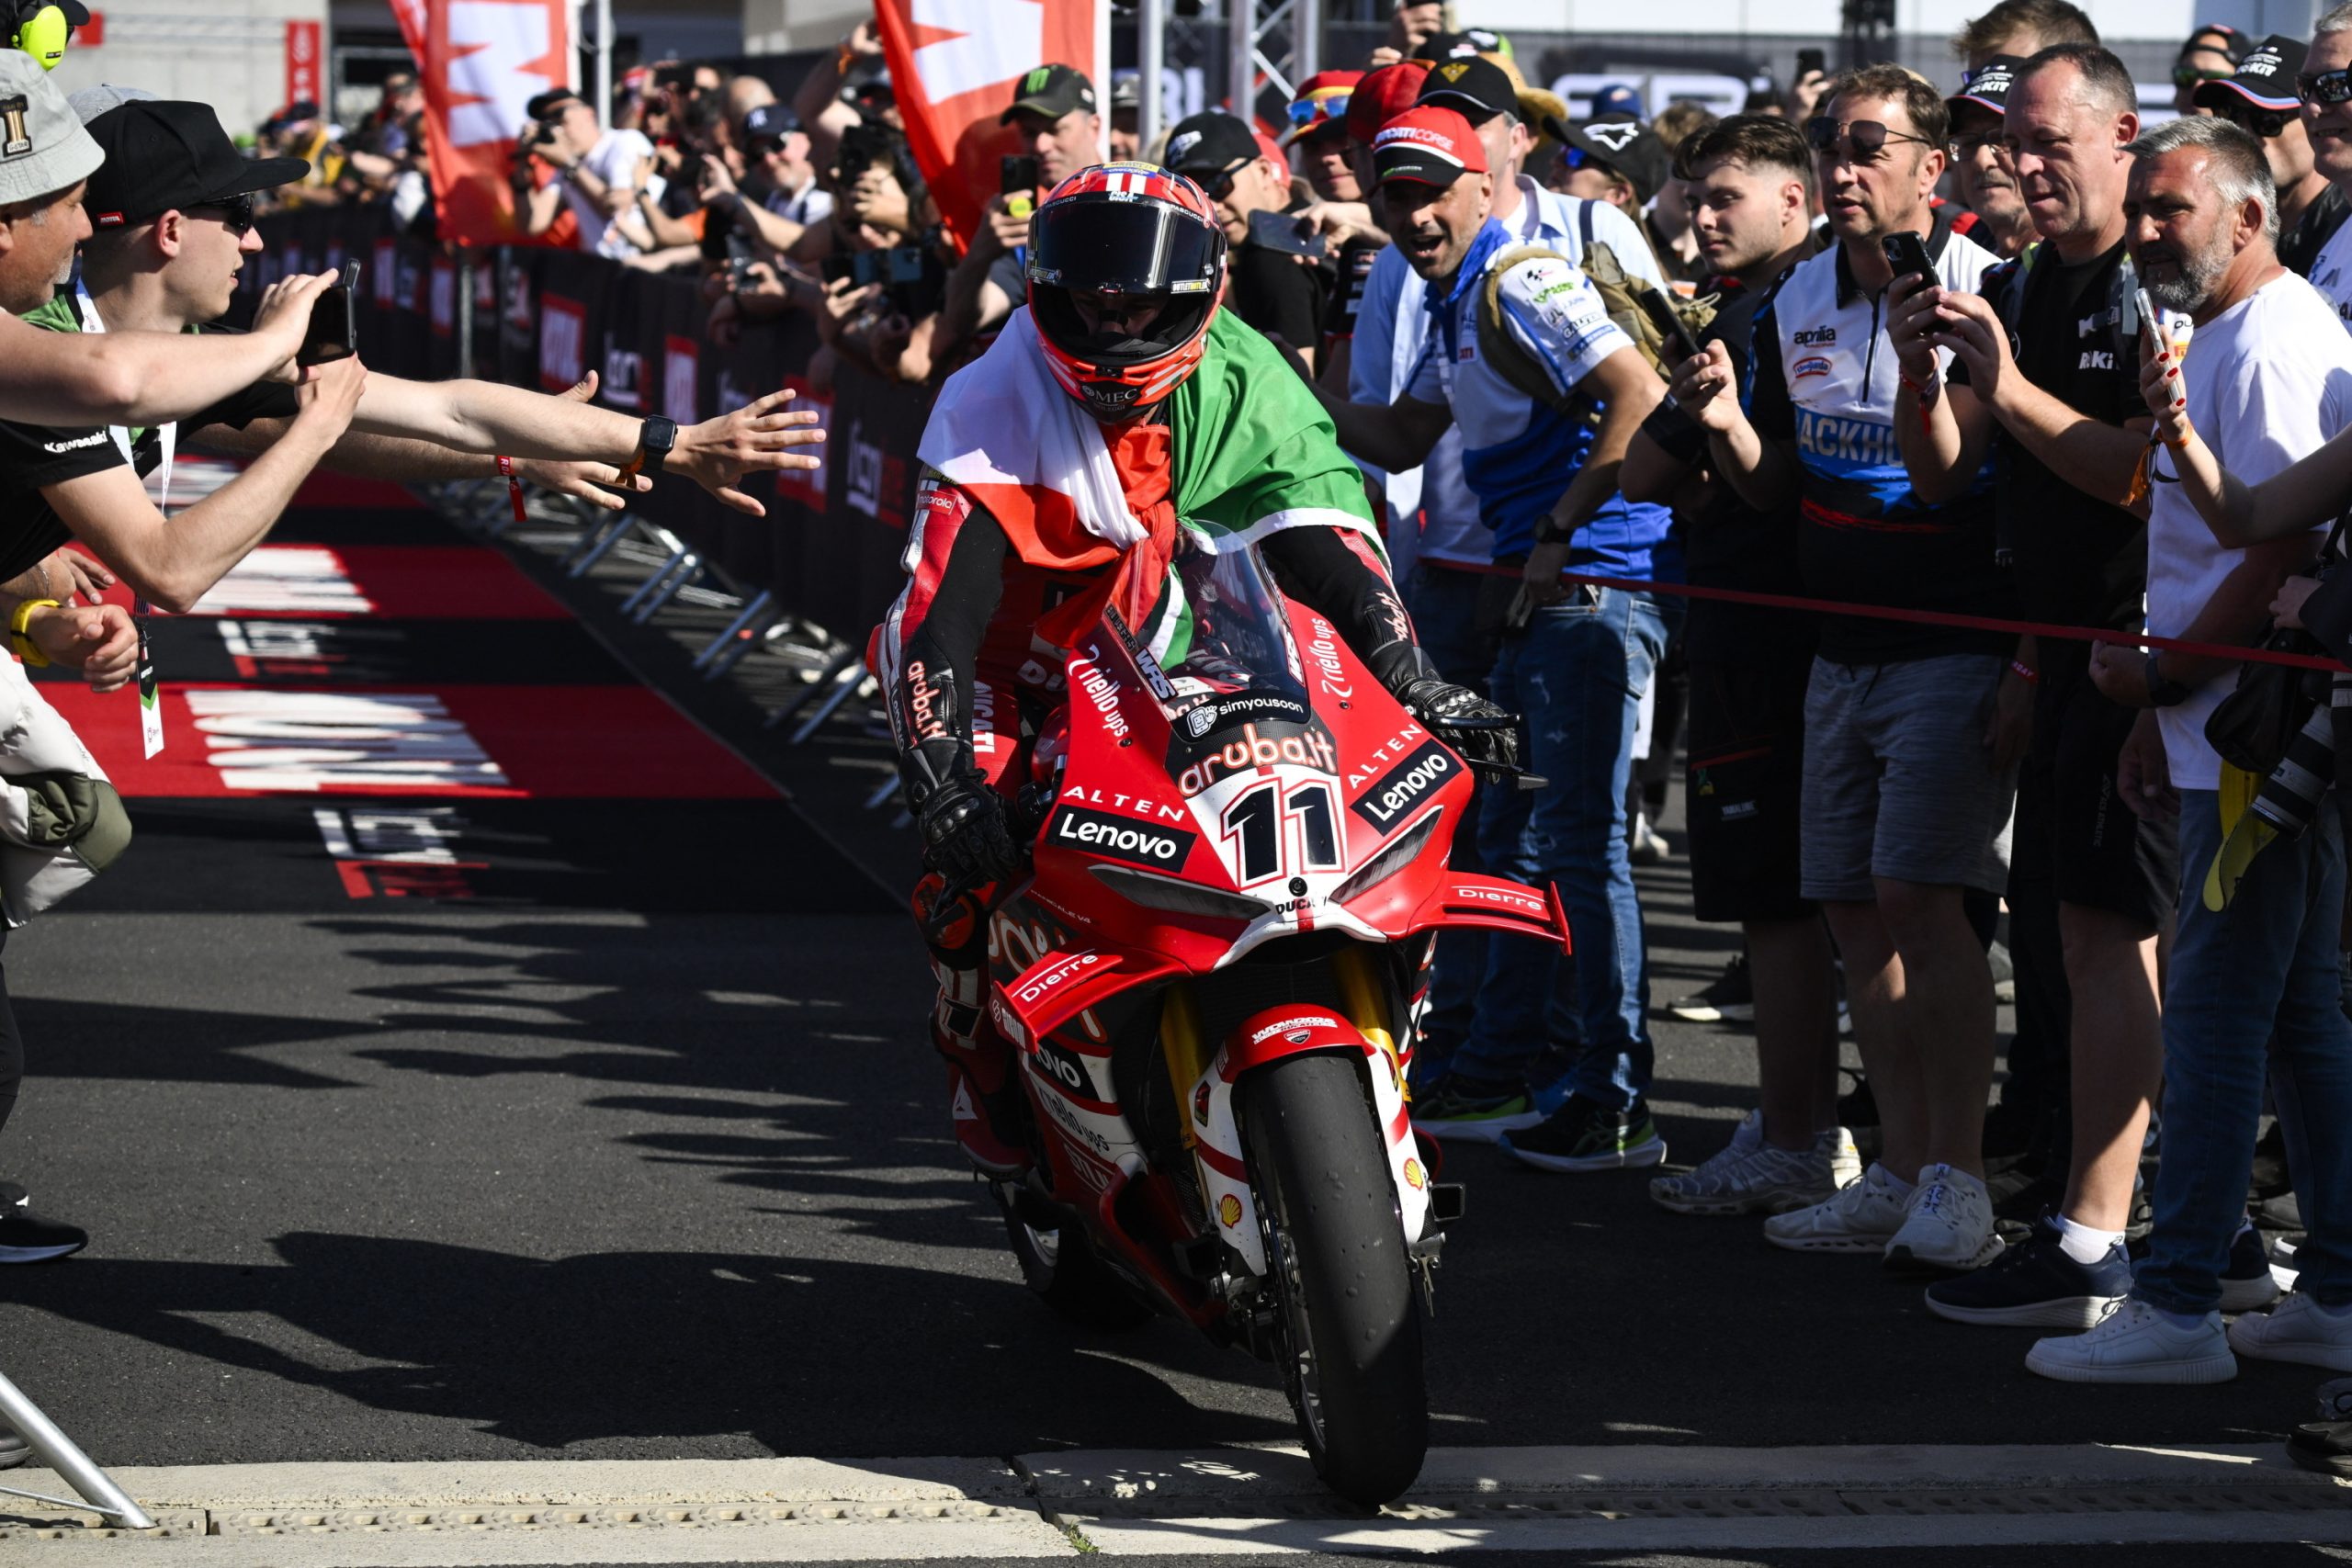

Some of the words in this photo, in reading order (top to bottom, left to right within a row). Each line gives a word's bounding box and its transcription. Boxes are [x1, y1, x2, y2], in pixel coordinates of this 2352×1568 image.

[1793, 325, 1837, 348] aprilia
[44, 430, 108, 454] Kawasaki
[1311, 617, 1336, 640] ups
[1135, 648, 1177, 699] WRS
[1077, 667, 1122, 713] riello
[1102, 709, 1130, 740] ups
[1219, 697, 1305, 716] simyousoon
[1178, 722, 1338, 798] aruba.it
[1348, 723, 1423, 790] ALTEN
[1063, 785, 1185, 823] ALTEN
[1364, 754, 1448, 822] Lenovo
[1059, 812, 1177, 860] Lenovo
[1225, 782, 1342, 886] 11
